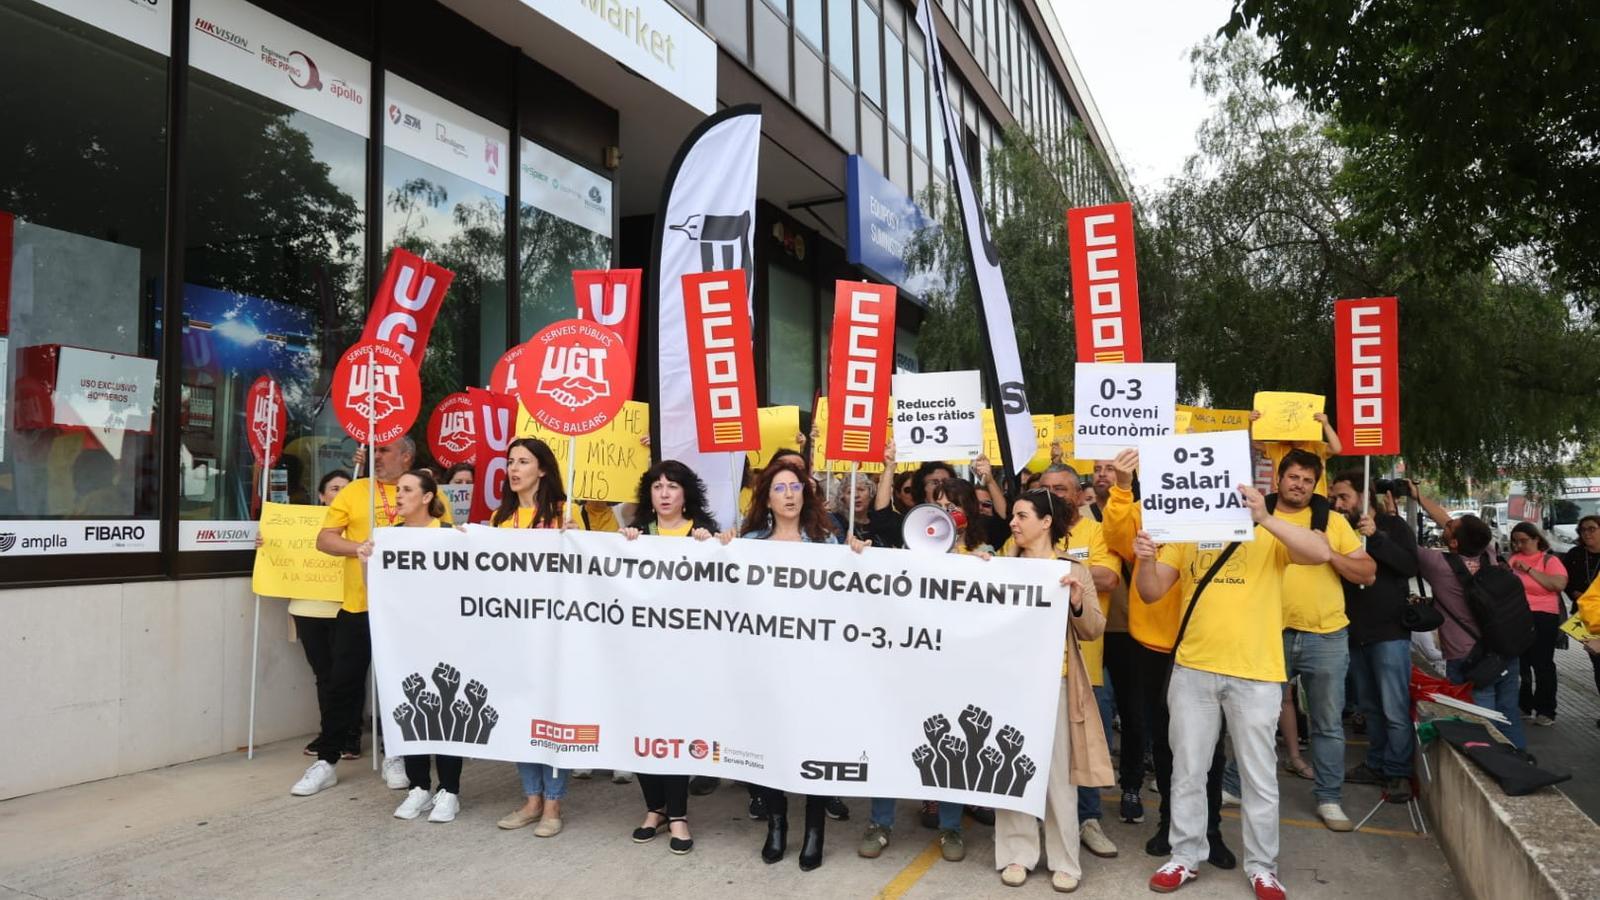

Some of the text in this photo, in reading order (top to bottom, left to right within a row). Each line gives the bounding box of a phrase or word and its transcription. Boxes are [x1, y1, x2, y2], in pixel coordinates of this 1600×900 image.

[195, 18, 250, 48] HIKVISION
[261, 53, 278, 68] FIRE
[330, 82, 363, 105] apollo
[1084, 214, 1124, 348] CCOO
[376, 266, 435, 356] UG
[540, 325, 613, 348] SERVEIS PÚBLICS
[347, 344, 404, 364] SERVEIS PÚBLICS
[698, 280, 741, 418] CCOO
[844, 291, 881, 427] CCOO
[541, 346, 608, 381] UGT
[1351, 306, 1383, 425] CCOO
[80, 379, 97, 389] USO
[349, 365, 400, 396] UGT
[1099, 378, 1143, 401] 0-3
[897, 397, 956, 410] Reducció
[1090, 403, 1159, 420] Conveni
[440, 410, 476, 437] UGT
[536, 409, 561, 430] ILLES
[563, 412, 608, 433] BALEARS
[897, 410, 976, 422] de les ràtios
[346, 422, 366, 441] ILLES
[910, 425, 949, 444] 0-3
[1078, 422, 1170, 438] autonòmic
[482, 404, 509, 511] UG
[587, 440, 637, 469] MIRAR
[1173, 447, 1215, 466] 0-3
[1160, 470, 1230, 490] Salari
[1143, 492, 1249, 514] digne, JA!
[84, 526, 146, 541] FIBARO
[196, 530, 250, 540] HIKVISION
[382, 550, 427, 571] PER
[433, 550, 469, 571] UN
[475, 552, 583, 574] CONVENI
[588, 555, 741, 582] AUTONÒMIC
[919, 577, 1052, 608] INFANTIL
[460, 596, 942, 652] DIGNIFICACIÓ ENSENYAMENT 0-3, JA!
[535, 723, 576, 741] CCOO
[530, 738, 600, 754] ensenyament
[634, 736, 685, 759] UGT
[799, 759, 868, 782] STEI
